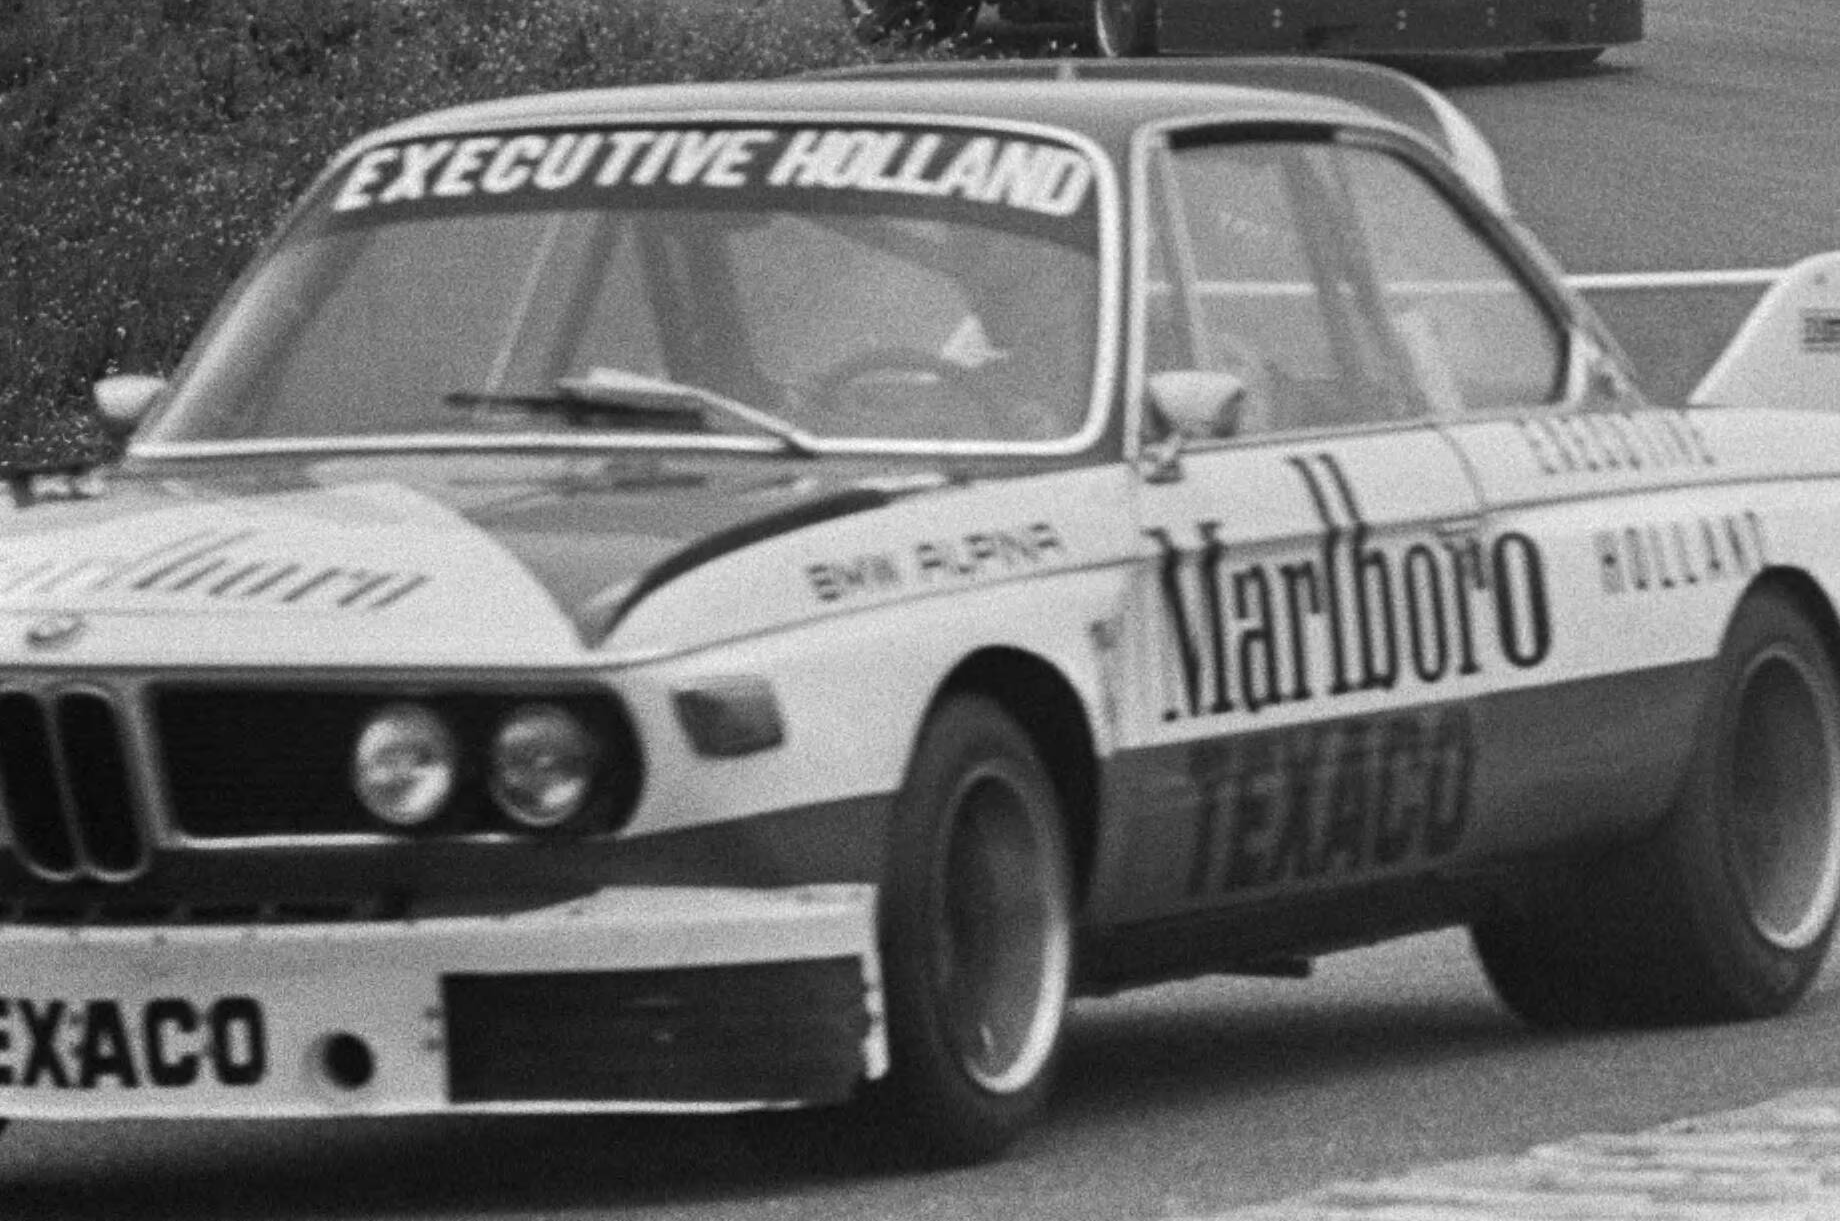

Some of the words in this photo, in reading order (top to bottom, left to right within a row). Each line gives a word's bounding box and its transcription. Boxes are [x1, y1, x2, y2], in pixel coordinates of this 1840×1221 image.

[334, 130, 780, 213] EXECUTIVE
[767, 130, 1094, 217] HOLLAND
[1142, 451, 1549, 723] Marlboro
[1187, 704, 1476, 897] TEXACO
[0, 996, 266, 1090] XACO
